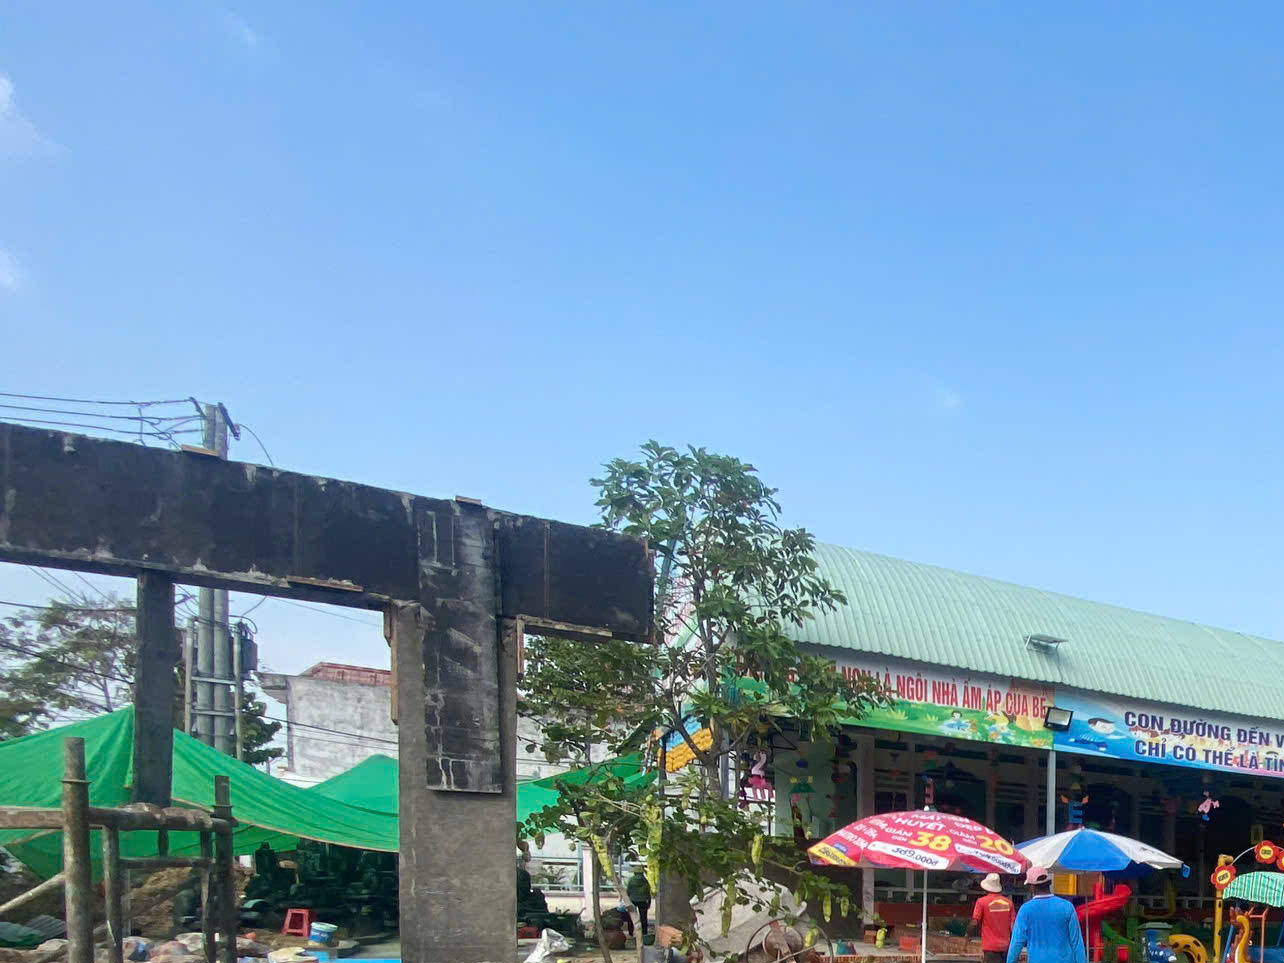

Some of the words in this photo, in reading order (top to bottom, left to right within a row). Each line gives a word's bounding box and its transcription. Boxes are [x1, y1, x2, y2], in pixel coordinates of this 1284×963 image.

[896, 672, 928, 702] NGÔI
[932, 678, 959, 707] NHÀ
[985, 684, 1002, 713] ÁP
[1124, 711, 1164, 731] CON
[1170, 719, 1231, 741] ĐƯỜNG
[1237, 726, 1270, 746] ĐẾN
[1135, 738, 1166, 758] CHỈ
[1173, 743, 1197, 761] CÓ
[1240, 752, 1259, 769] LÀ
[908, 831, 952, 851] 38
[976, 834, 1014, 856] 20
